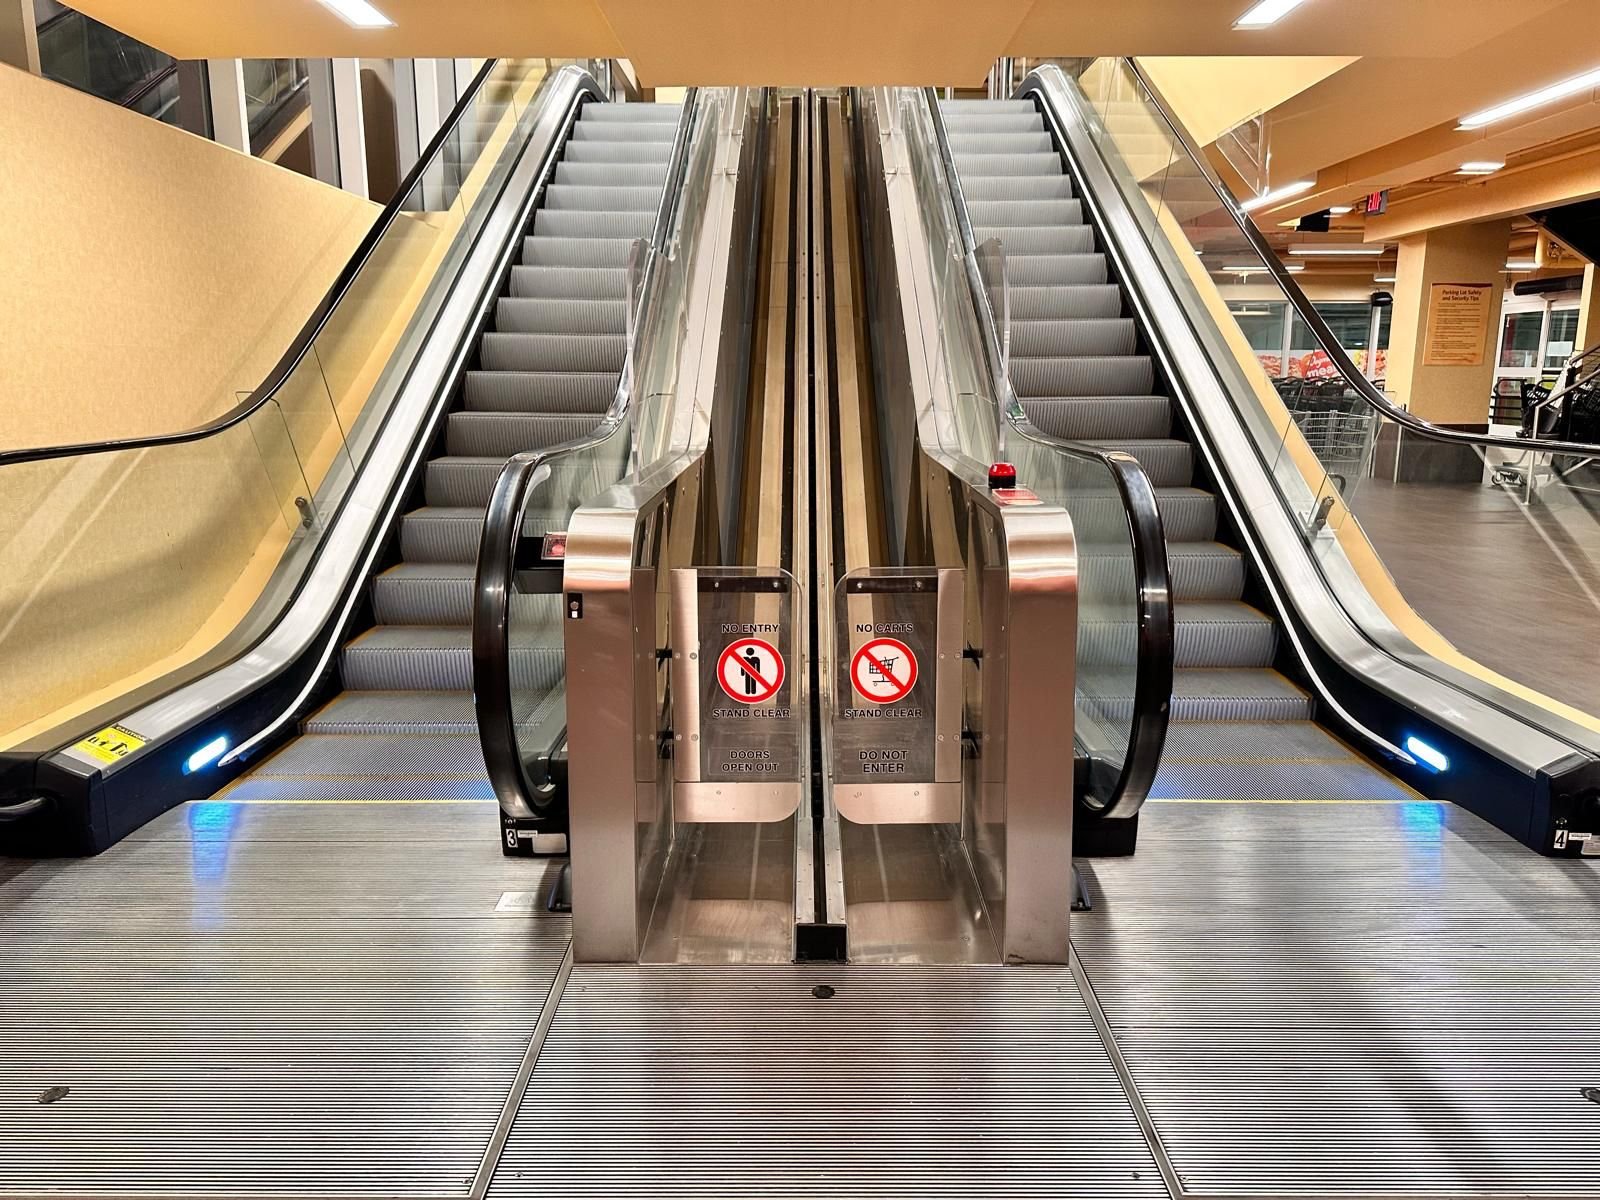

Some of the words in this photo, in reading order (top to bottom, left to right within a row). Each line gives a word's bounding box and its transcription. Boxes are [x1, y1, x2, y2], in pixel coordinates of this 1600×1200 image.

[722, 624, 739, 633] NO
[742, 624, 779, 633] ENTRY
[856, 624, 872, 633] NO
[875, 623, 913, 633] CARTS
[713, 709, 750, 718] STAND
[753, 709, 791, 718] CLEAR
[845, 709, 883, 718] STAND
[885, 709, 922, 718] CLEAR
[730, 751, 770, 760] DOORS
[859, 750, 878, 760] DO
[881, 750, 908, 760] NOT
[722, 763, 752, 772] OPEN
[756, 763, 778, 772] OUT
[863, 762, 904, 773] ENTER
[507, 830, 516, 846] 3
[1555, 830, 1565, 847] 4
